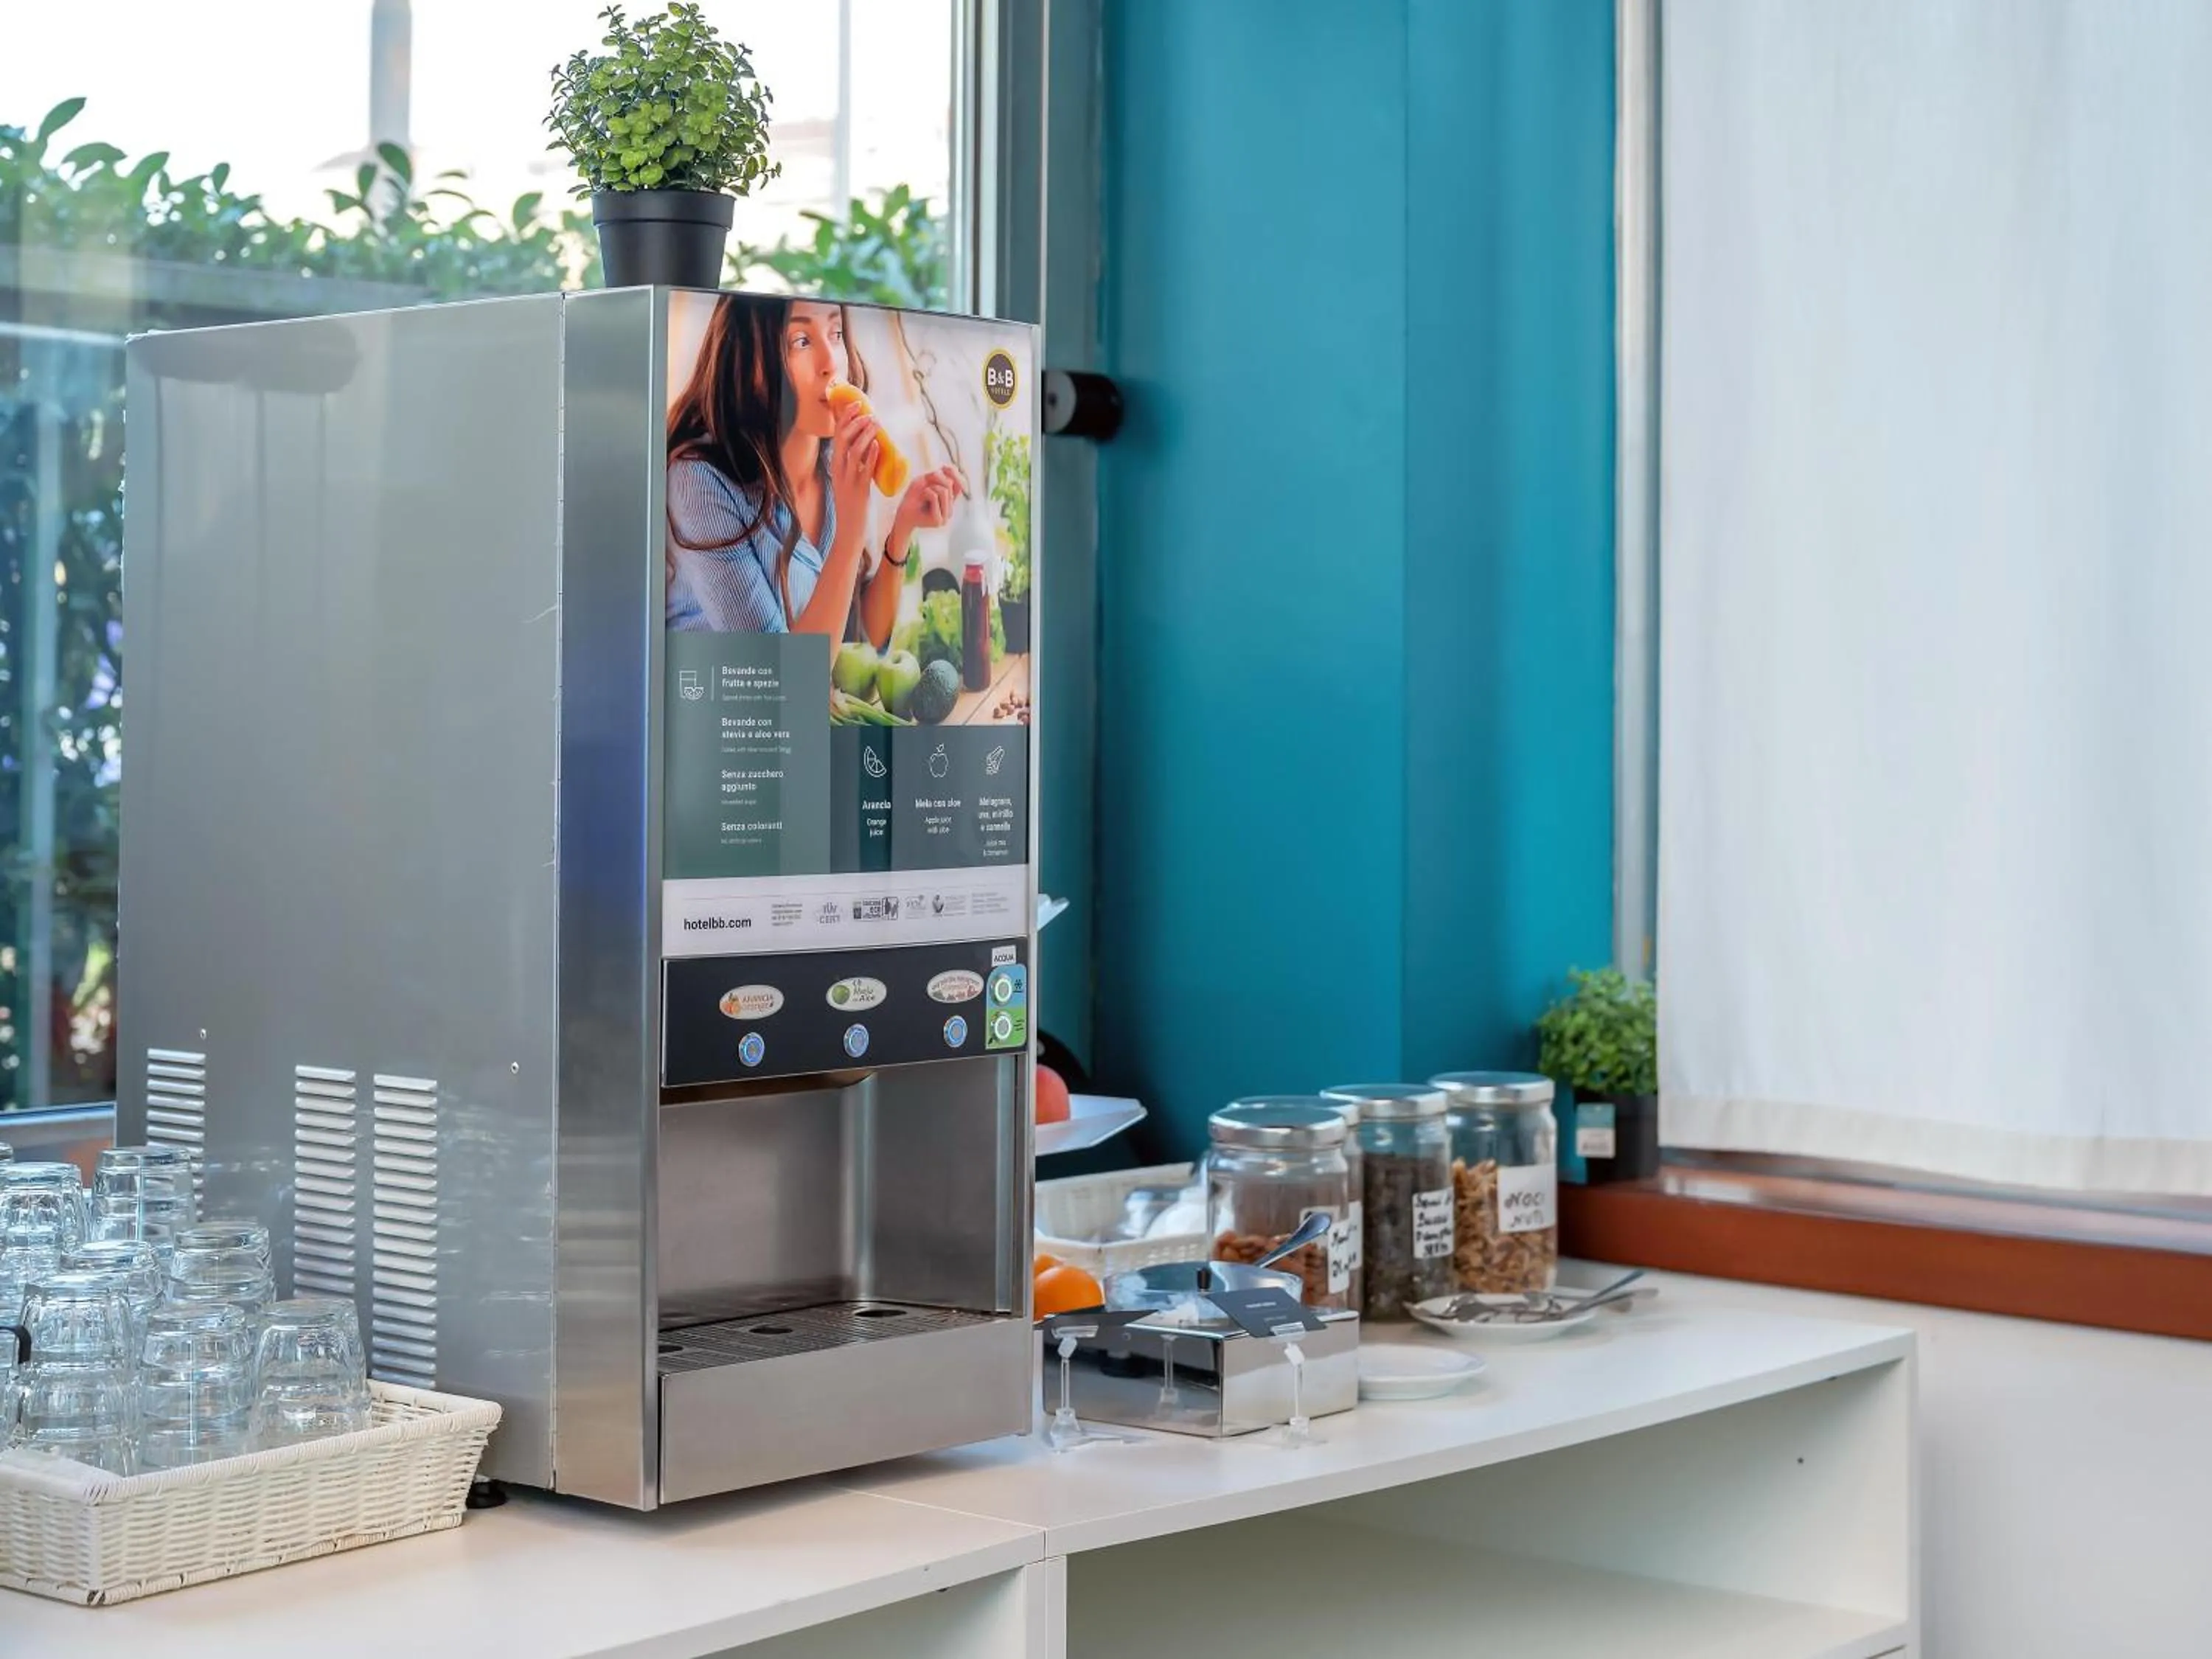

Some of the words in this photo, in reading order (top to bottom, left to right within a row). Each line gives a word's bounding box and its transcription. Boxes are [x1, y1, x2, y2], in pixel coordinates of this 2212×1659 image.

[987, 367, 1014, 388] B&B
[722, 666, 756, 675] Bevande
[722, 678, 745, 687] frutta
[753, 679, 779, 689] spezie
[722, 717, 756, 726] Bevande
[722, 729, 746, 738] stevia
[754, 729, 772, 738] aloe
[722, 770, 746, 779] Senza
[748, 769, 784, 778] zucchero
[721, 782, 757, 793] aggiunto
[862, 799, 891, 810] Arancia
[721, 822, 745, 831] Senza
[747, 820, 783, 830] coloranti
[683, 916, 752, 931] hotelbb.com
